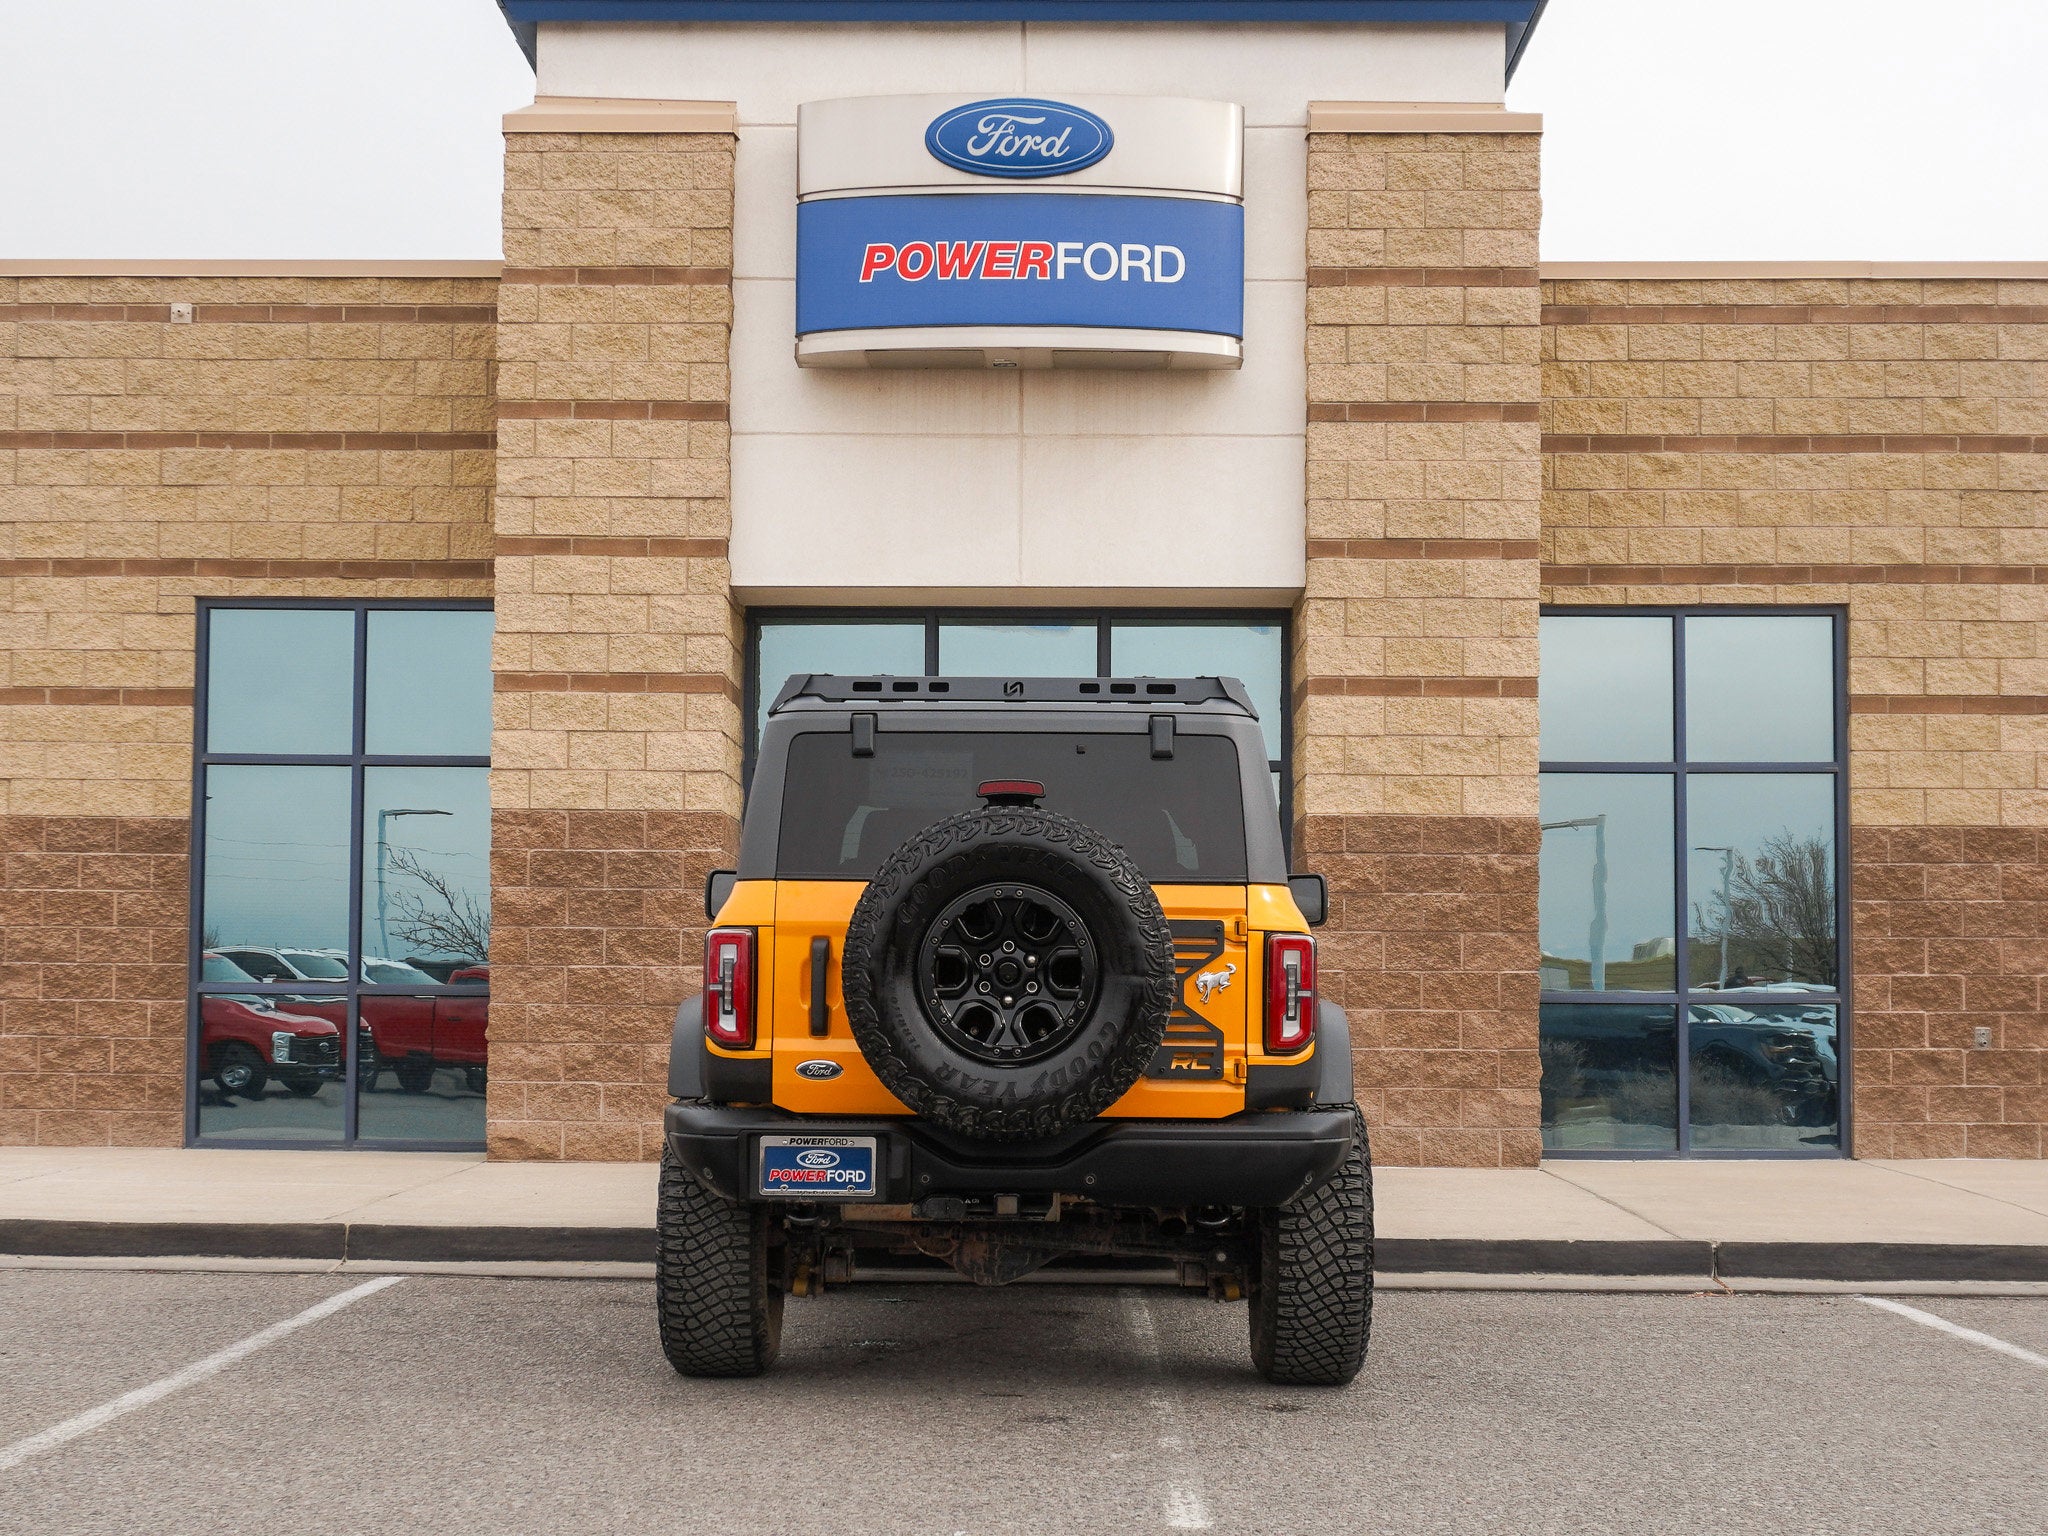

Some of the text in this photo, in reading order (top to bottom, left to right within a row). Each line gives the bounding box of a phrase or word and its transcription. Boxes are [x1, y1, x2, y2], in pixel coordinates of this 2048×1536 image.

[966, 114, 1072, 158] Ford
[859, 240, 1187, 283] POWERFORD
[806, 1064, 833, 1077] Ford
[789, 1138, 848, 1146] POWERFORD
[805, 1153, 831, 1165] Ford
[769, 1169, 866, 1183] POWERFORD
